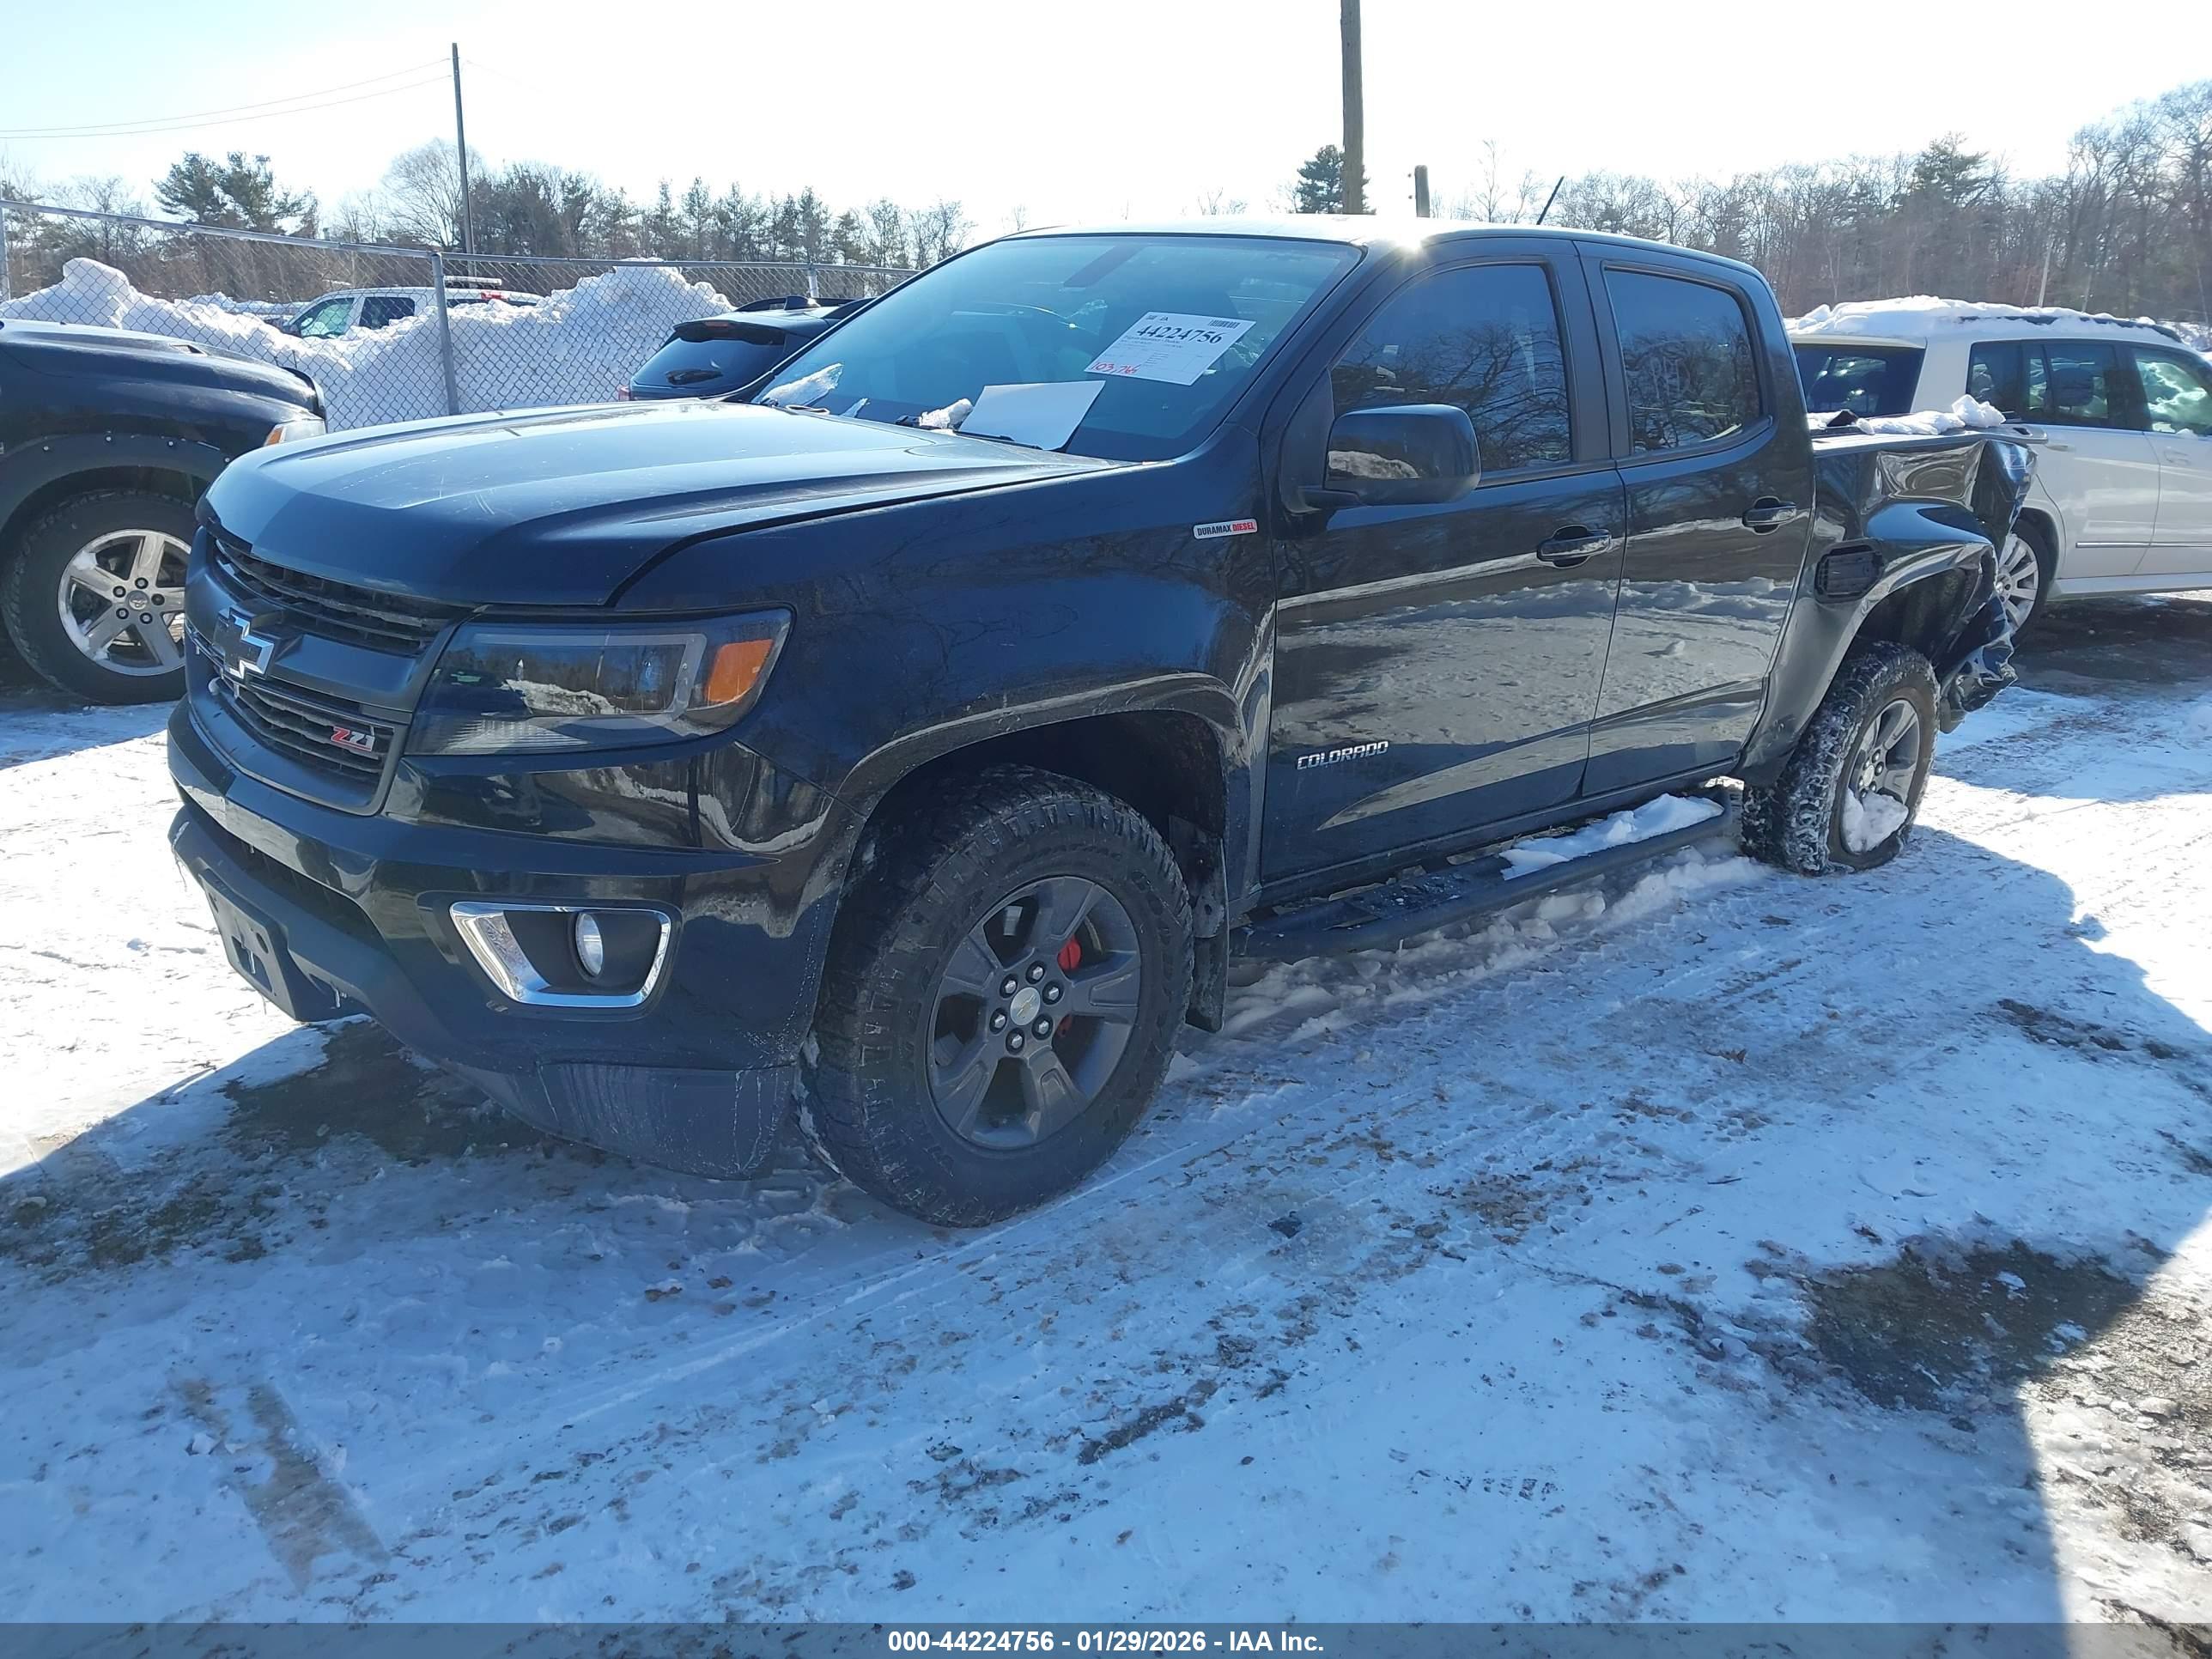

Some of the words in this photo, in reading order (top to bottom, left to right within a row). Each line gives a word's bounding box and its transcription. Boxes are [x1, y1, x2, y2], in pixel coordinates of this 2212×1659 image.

[1137, 325, 1228, 343] 44224756
[1196, 525, 1231, 536] DURAMAX
[1232, 521, 1255, 532] DIESEL
[331, 726, 375, 752] Z71
[1297, 740, 1389, 770] COLORADO
